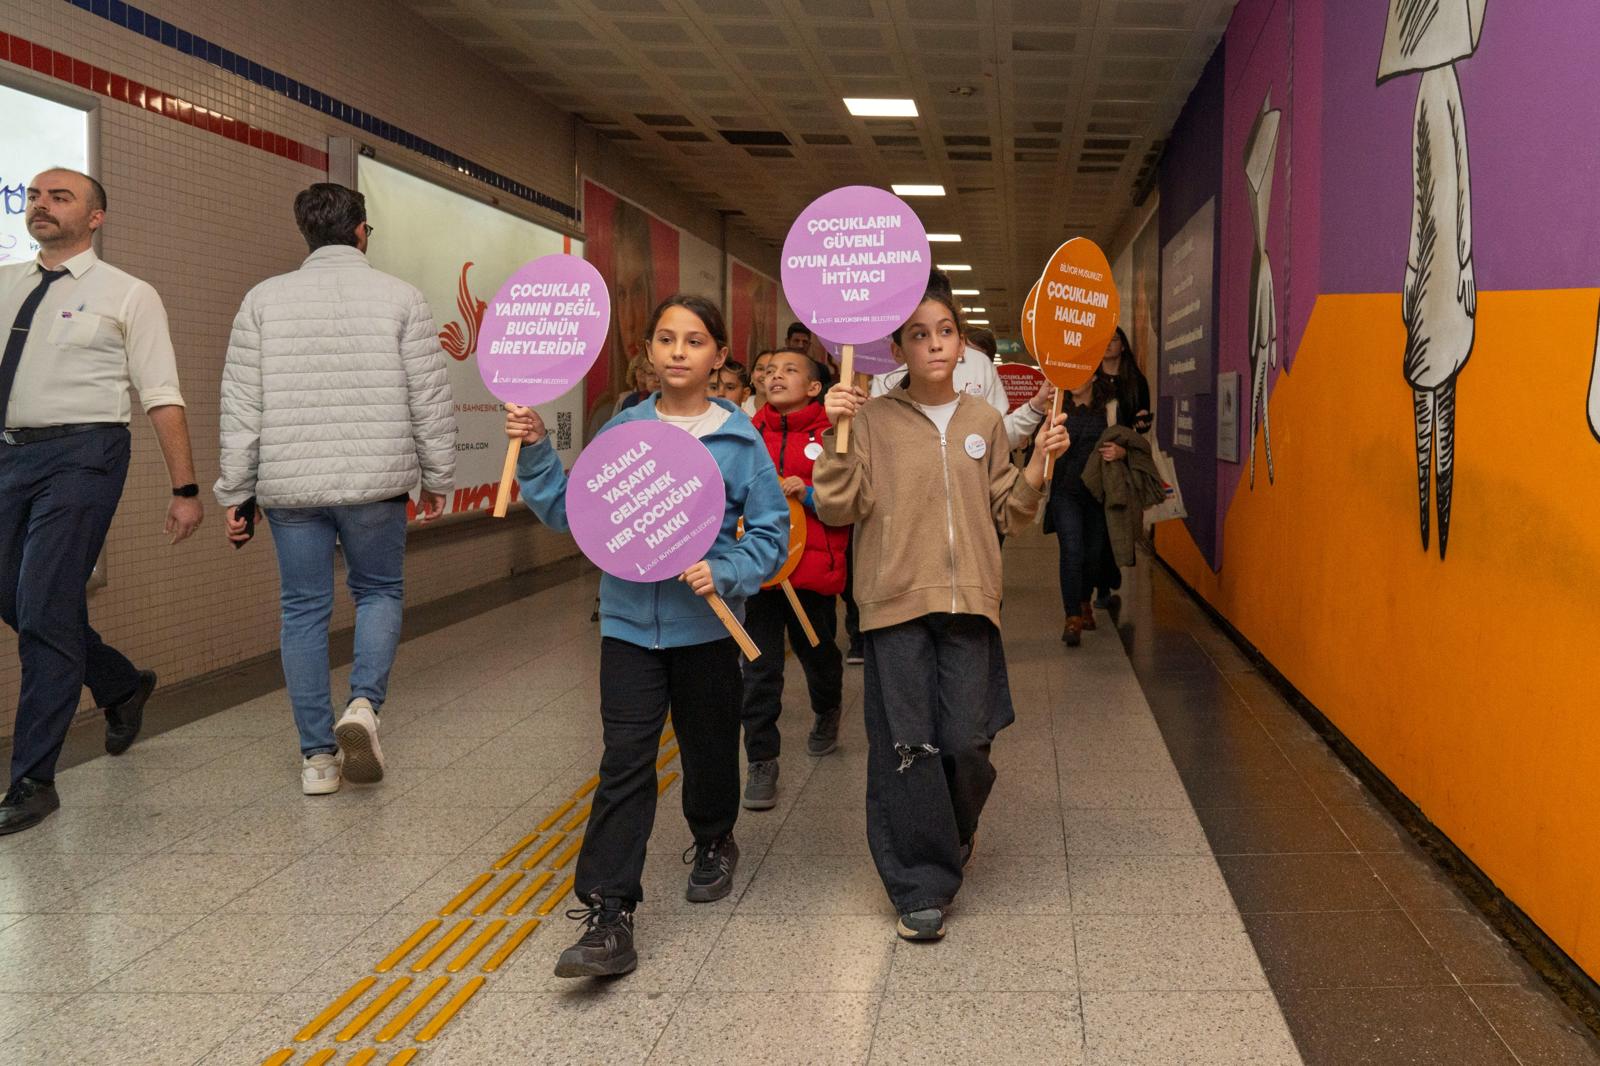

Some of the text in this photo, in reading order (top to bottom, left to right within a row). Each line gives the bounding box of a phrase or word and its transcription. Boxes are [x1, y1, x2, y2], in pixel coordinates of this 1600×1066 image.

[807, 215, 902, 235] ÇOCUKLARIN
[823, 230, 885, 249] GÜVENLİ
[787, 250, 922, 269] OYUN ALANLARINA
[822, 268, 885, 285] İHTİYACI
[510, 283, 591, 300] ÇOCUKLAR
[841, 288, 870, 301] VAR
[1047, 280, 1109, 309] ÇOCUKLARIN
[495, 298, 601, 318] YARININ DEĞİL,
[1054, 305, 1096, 328] HAKLARI
[506, 318, 580, 335] BUGÜNÜN
[489, 336, 587, 355] BİREYLERİDİR
[1063, 329, 1082, 347] VAR
[586, 440, 653, 493] SAĞLIKLA
[601, 459, 657, 505] YAŞAYIP
[610, 470, 677, 525] GELİŞMEK
[605, 475, 703, 554] HER ÇOCUĞUN
[644, 510, 690, 549] HAKKI
